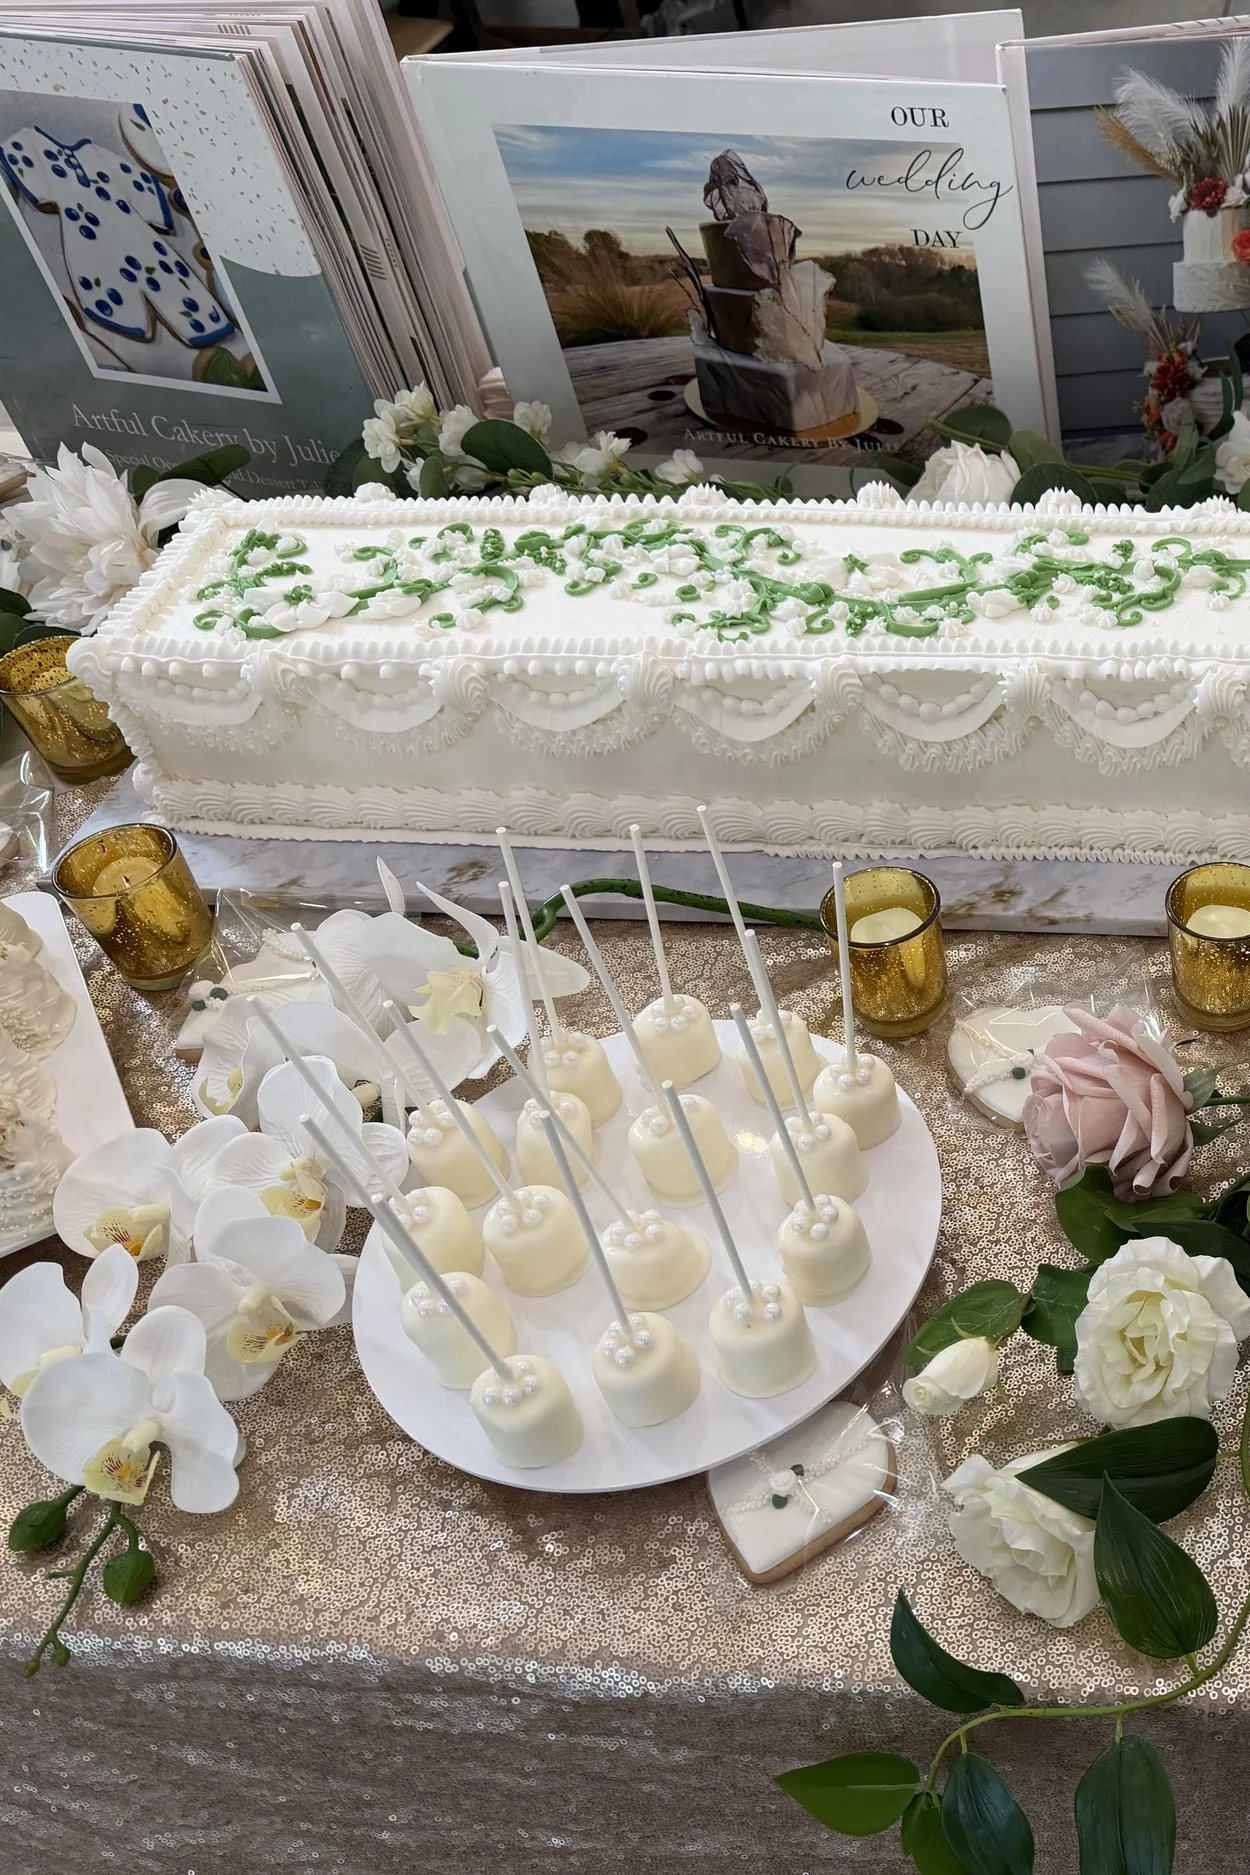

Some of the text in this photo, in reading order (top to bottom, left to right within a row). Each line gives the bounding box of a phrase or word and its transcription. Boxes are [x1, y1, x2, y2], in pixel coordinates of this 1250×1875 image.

[891, 106, 950, 127] OUR
[846, 147, 1014, 231] wedding
[910, 229, 962, 248] DAY
[72, 403, 149, 437] Artful
[242, 428, 277, 464] by
[282, 435, 341, 467] Julie
[105, 450, 150, 469] Special
